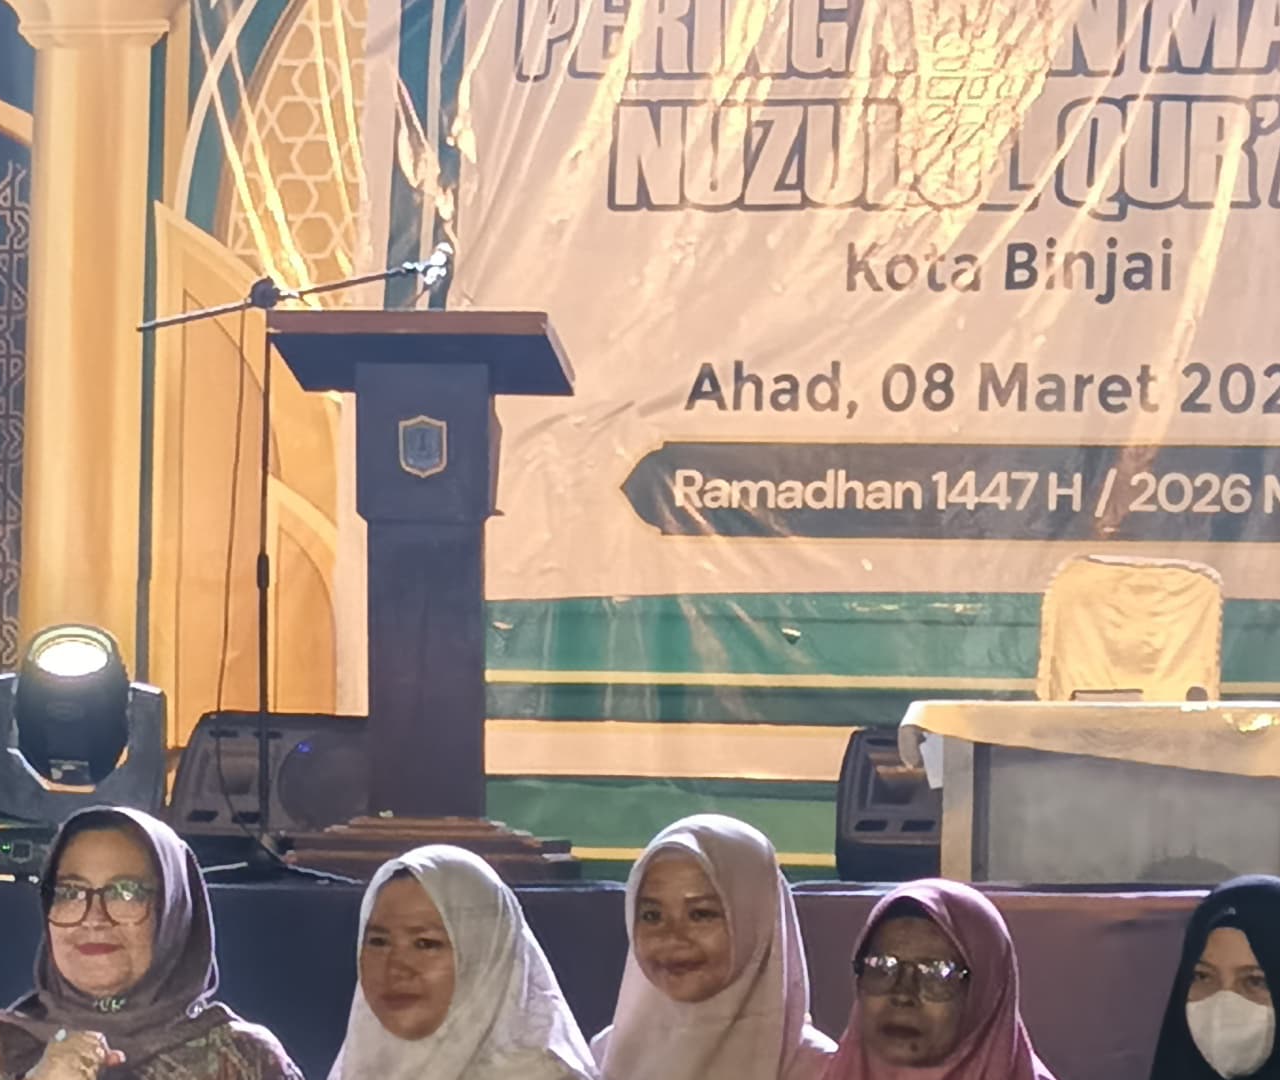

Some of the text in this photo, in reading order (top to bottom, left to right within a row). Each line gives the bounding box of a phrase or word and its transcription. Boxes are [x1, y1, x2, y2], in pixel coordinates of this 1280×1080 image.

[846, 236, 1173, 305] Kota Binjai
[684, 360, 858, 419] Ahad,
[882, 362, 955, 412] 08
[978, 362, 1160, 414] Maret
[674, 469, 923, 510] Ramadhan
[1094, 468, 1118, 518] /
[1129, 472, 1252, 514] 2026
